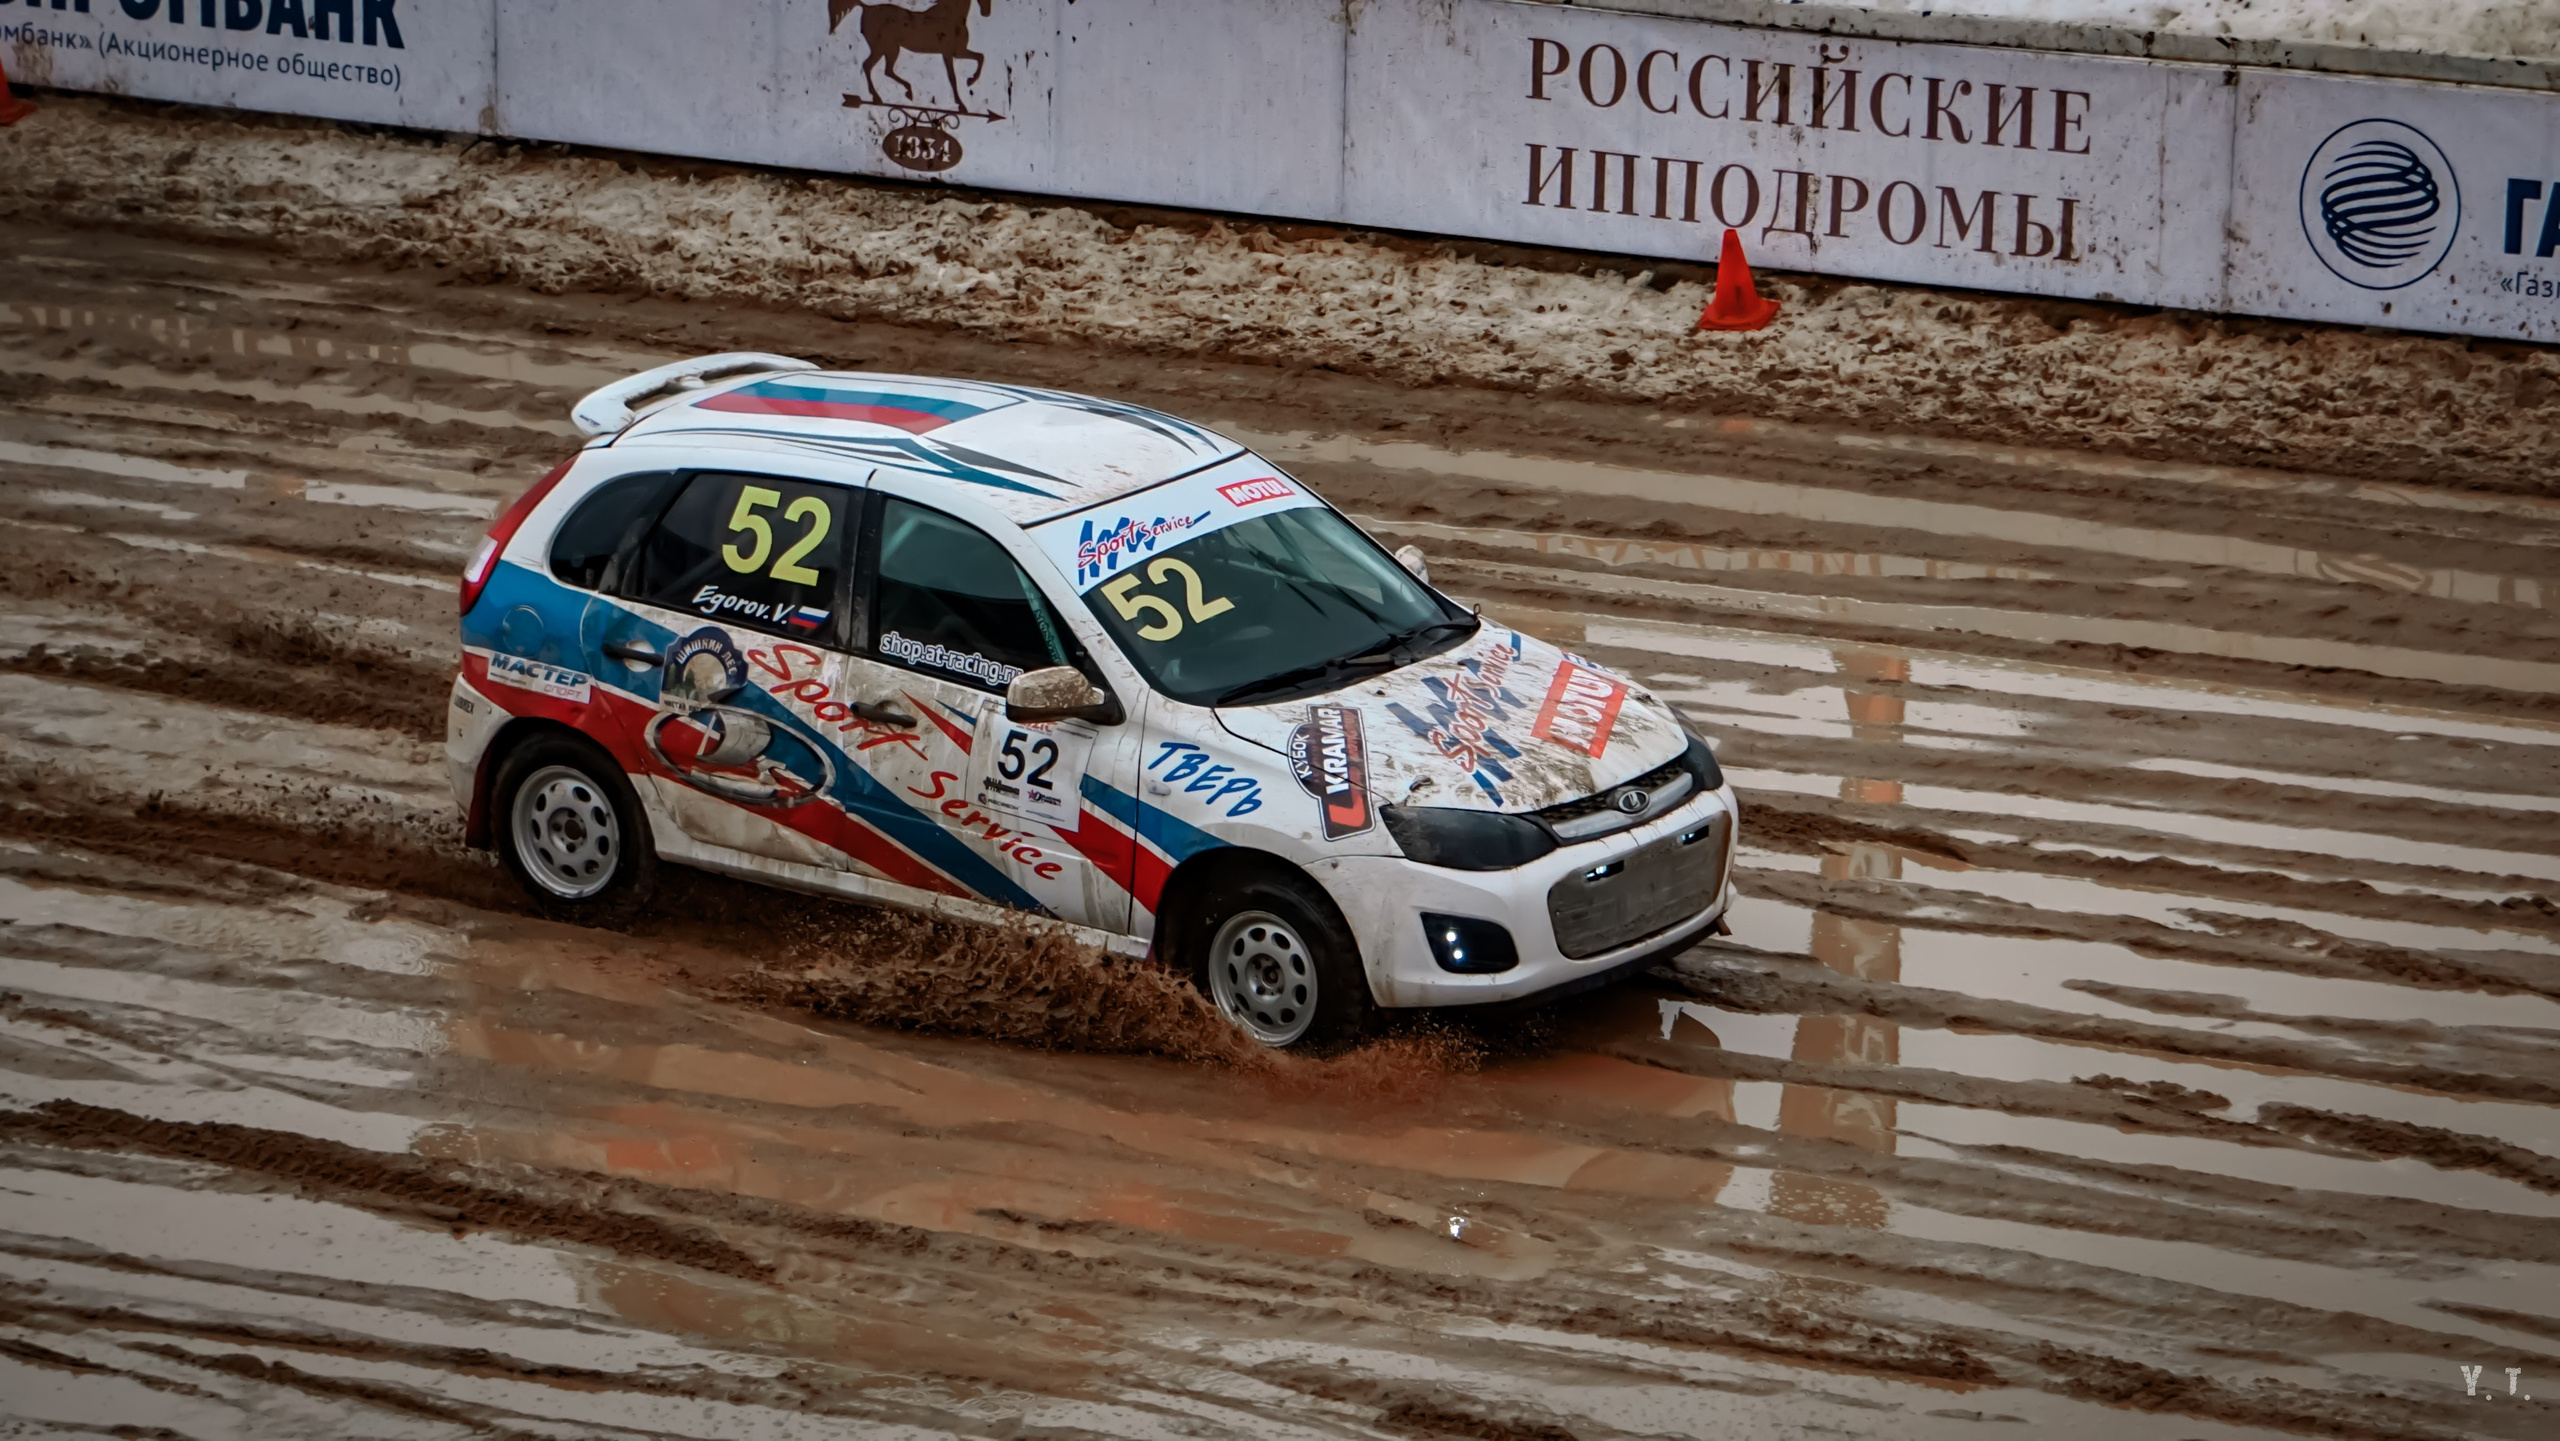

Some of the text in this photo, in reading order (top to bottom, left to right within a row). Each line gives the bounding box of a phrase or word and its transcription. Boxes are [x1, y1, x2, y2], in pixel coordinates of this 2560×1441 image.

[0, 22, 92, 49] мбанк»
[99, 31, 269, 72] (Акционерное
[277, 53, 402, 92] общество)
[1525, 36, 2093, 156] РОССИЙСКИЕ
[1521, 143, 2081, 262] ИППОДРОМЫ
[2500, 271, 2560, 298] «Газ
[1225, 479, 1291, 504] MOTUL
[722, 485, 831, 587] 52
[1078, 515, 1193, 568] Sport Service
[1100, 557, 1236, 642] 52
[491, 653, 588, 688] МАСТЕР
[676, 639, 723, 664] ШИШКИН
[1463, 643, 1516, 698] Service
[747, 644, 1063, 880] Sport Service
[997, 729, 1059, 791] 52
[1148, 741, 1262, 818] ТВЕРЬ
[1292, 733, 1313, 780] КУБОК
[1317, 708, 1350, 794] KRAMAR
